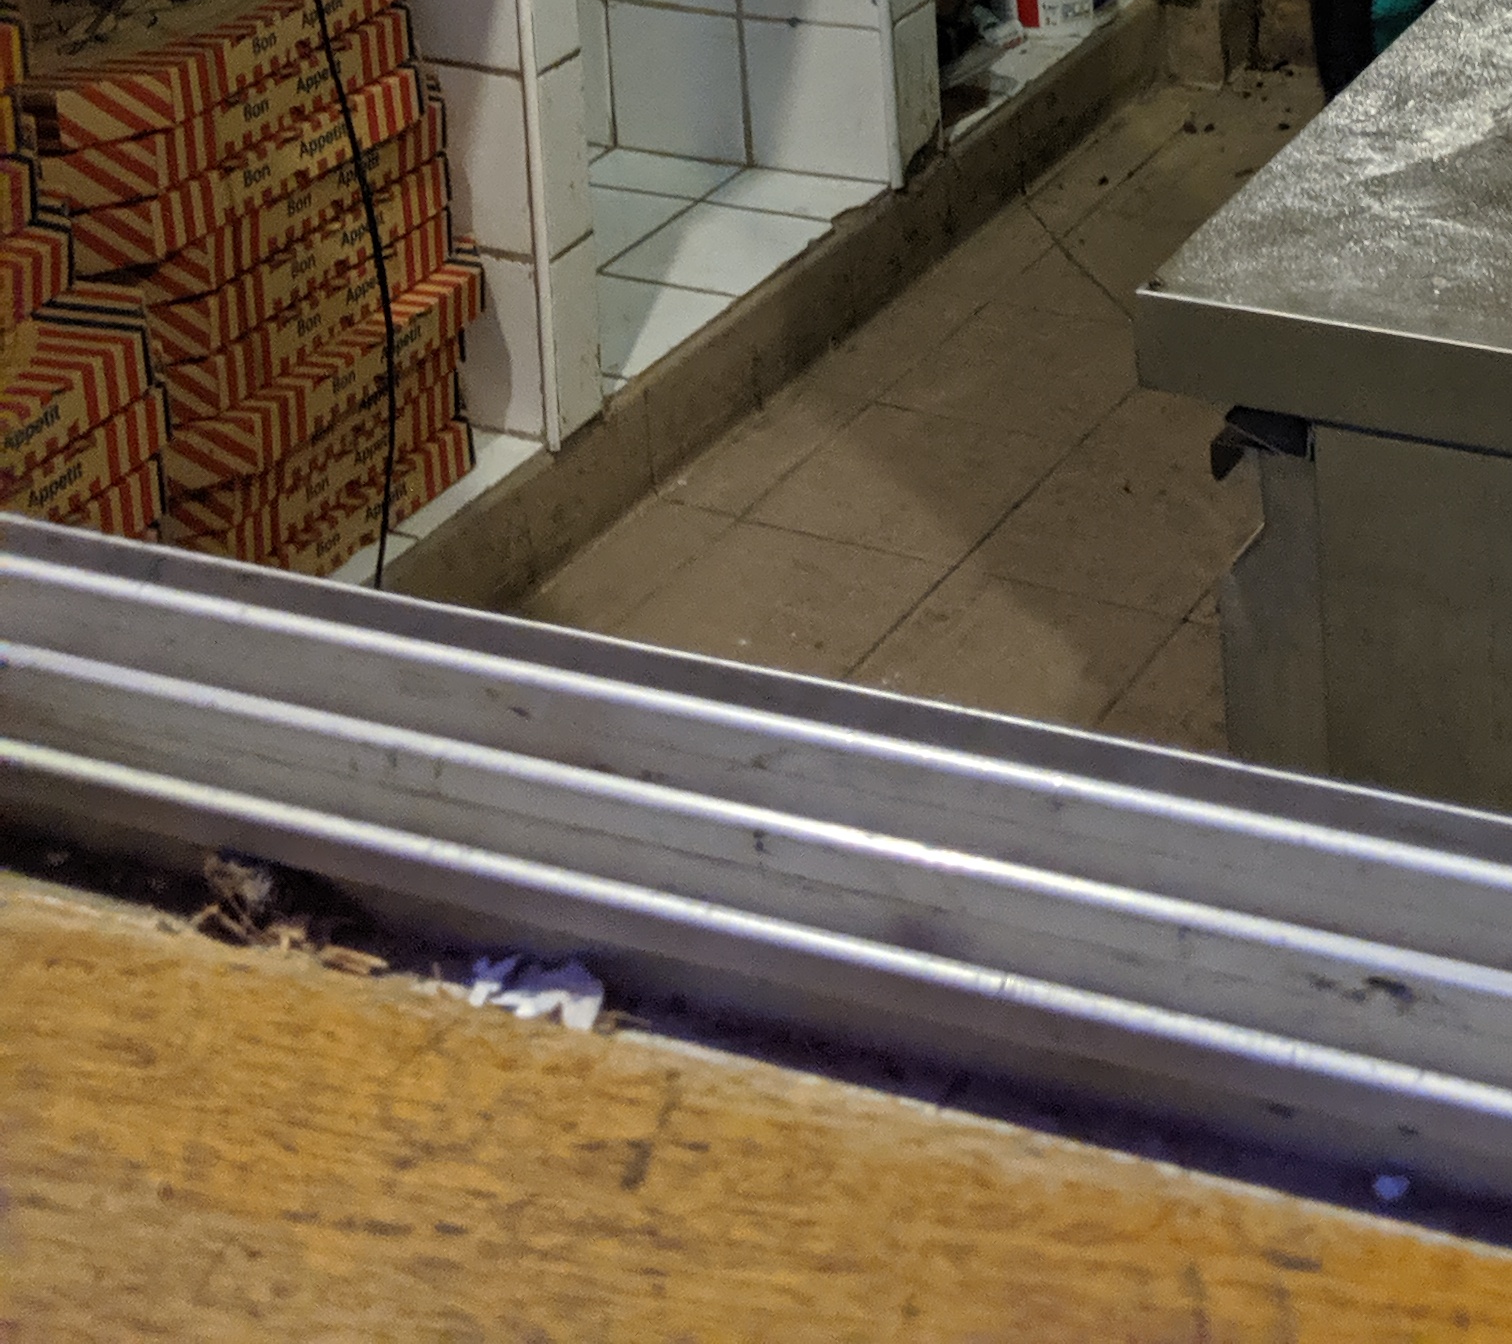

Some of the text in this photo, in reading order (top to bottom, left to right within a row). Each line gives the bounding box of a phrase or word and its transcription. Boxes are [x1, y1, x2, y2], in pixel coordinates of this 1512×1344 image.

[252, 32, 277, 55] Bon
[243, 59, 343, 123] Bon Appet
[243, 122, 349, 188] Bon Appetit
[286, 192, 313, 218] Bon
[297, 313, 322, 338] Bon
[332, 325, 423, 394] Bon Apetit
[4, 404, 62, 451] Appetit
[28, 462, 83, 508] Appetit
[316, 533, 342, 557] Bon
